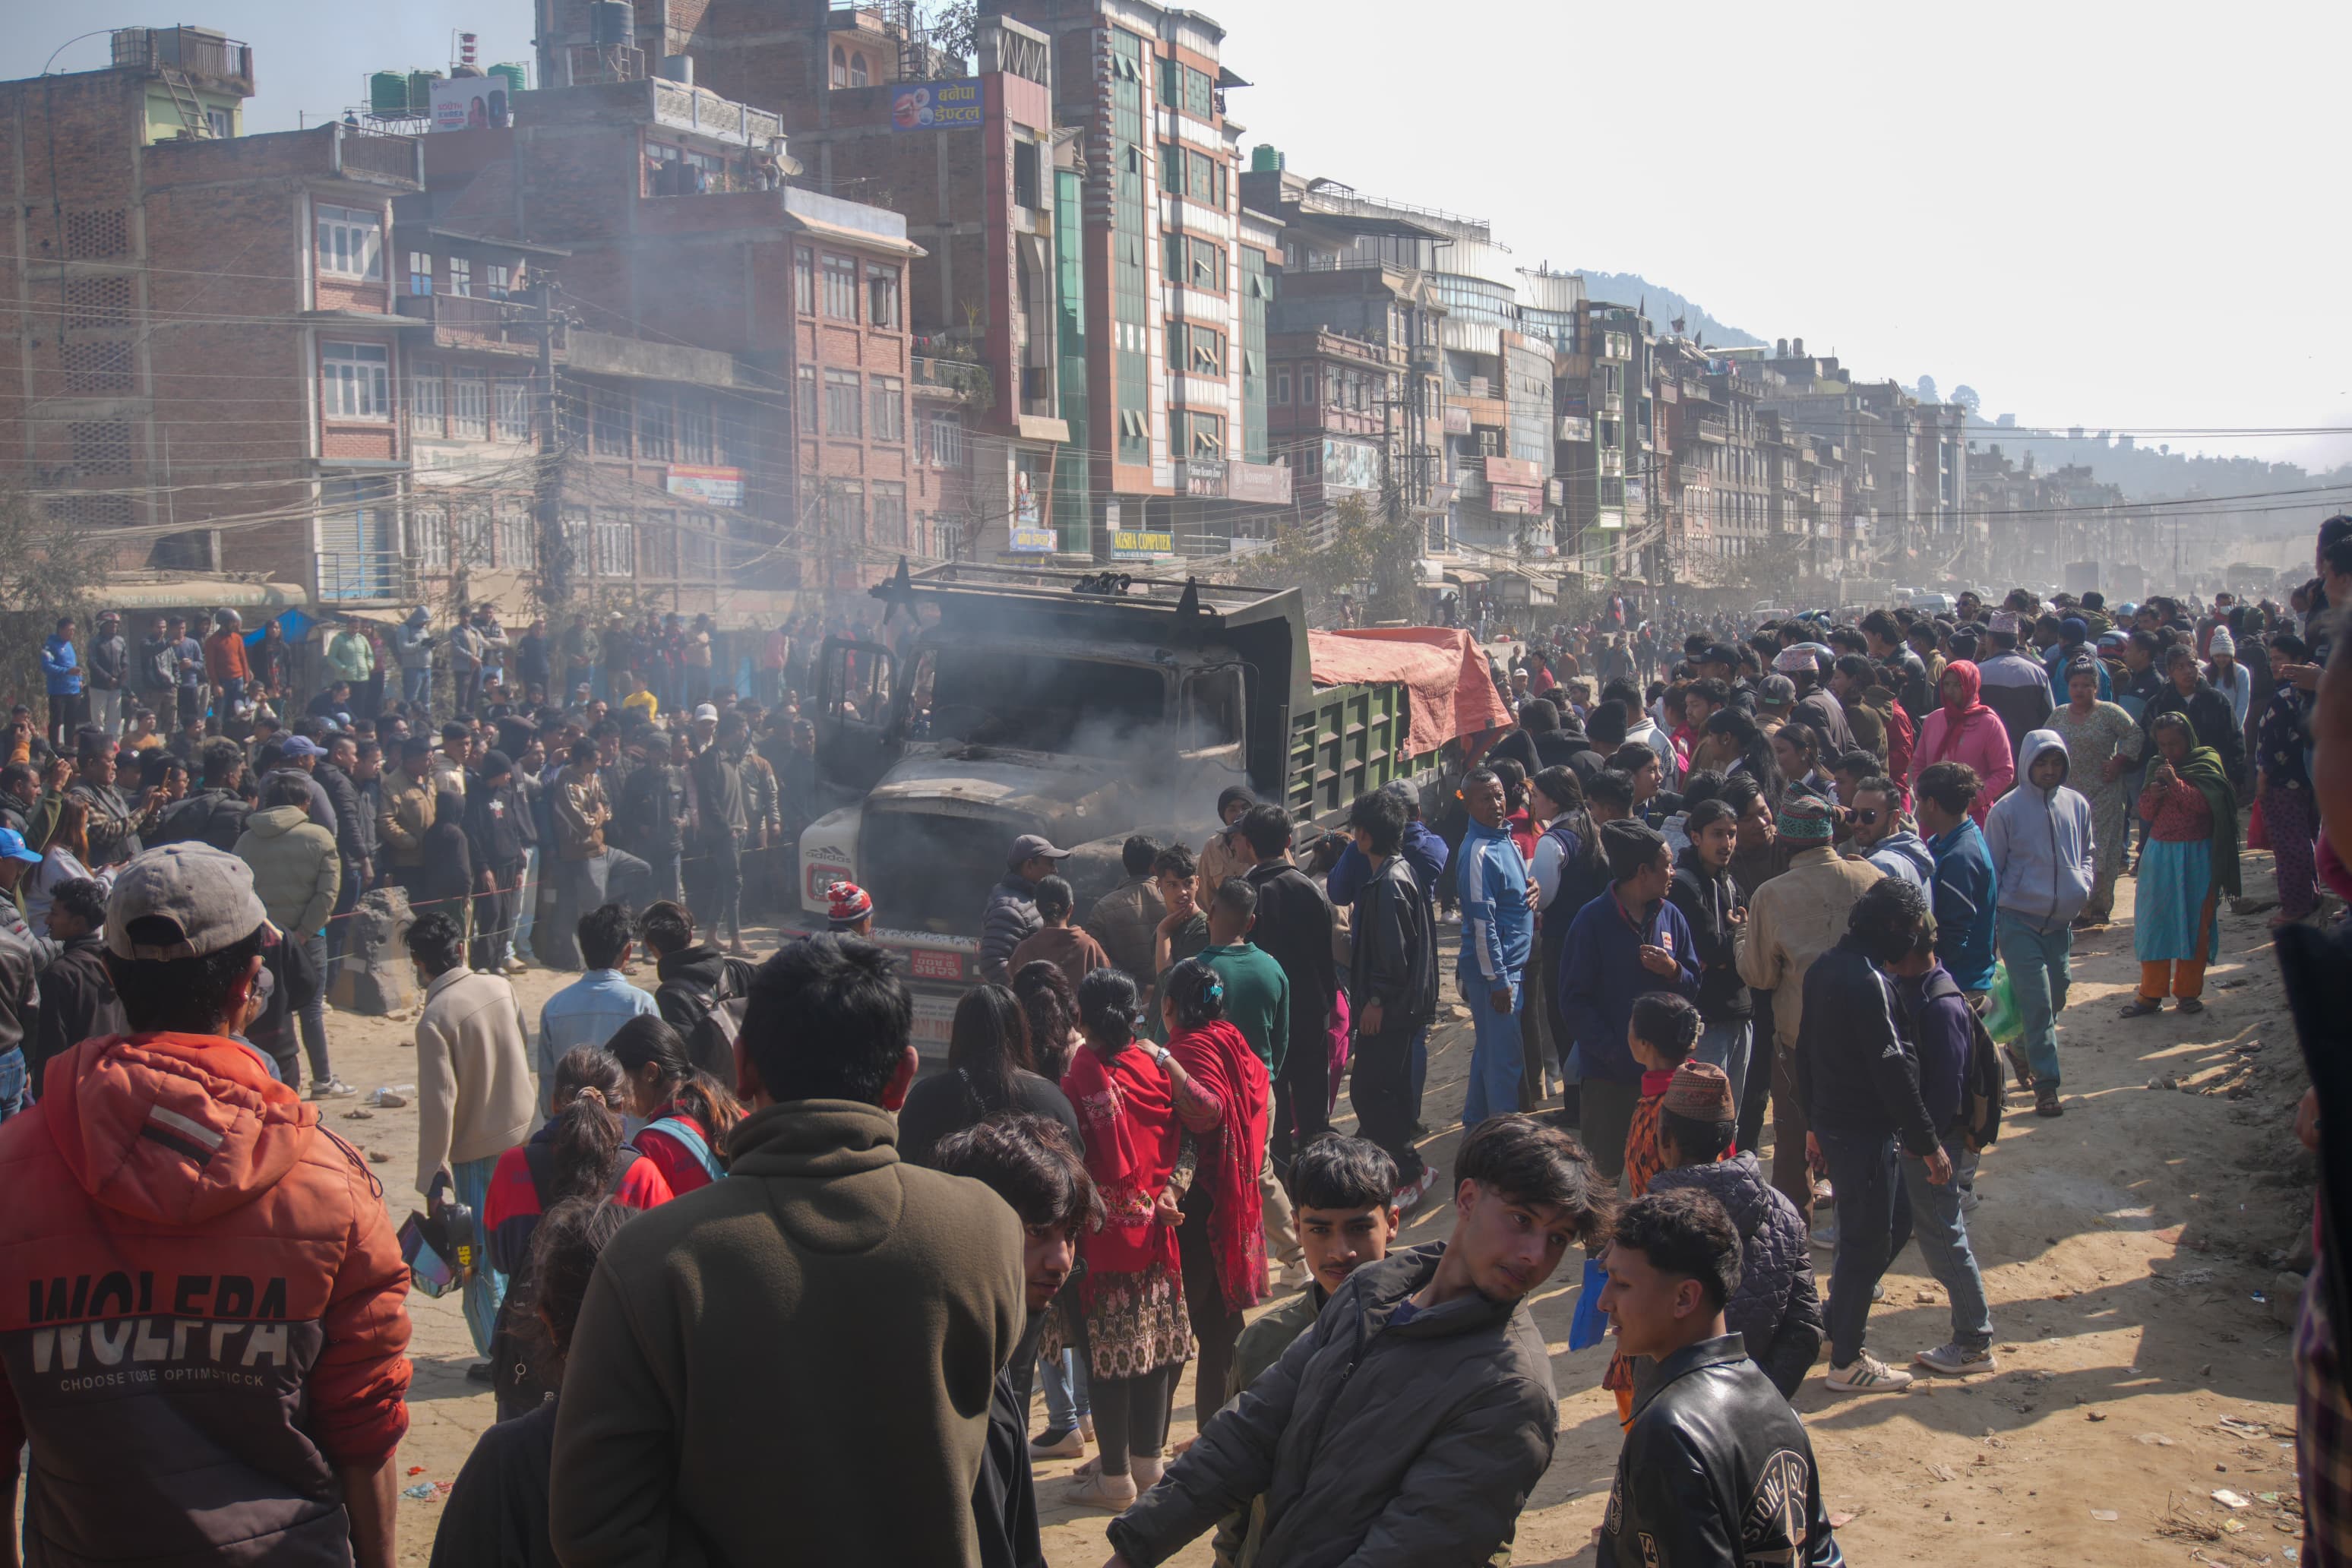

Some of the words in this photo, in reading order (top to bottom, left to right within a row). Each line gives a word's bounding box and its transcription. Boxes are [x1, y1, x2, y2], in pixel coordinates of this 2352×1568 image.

[938, 84, 975, 101] बनेपा
[934, 105, 980, 122] डेण्टल
[1244, 468, 1273, 485] November
[1114, 532, 1137, 549] AGSHA
[1138, 533, 1171, 551] COMPUTER
[805, 852, 851, 864] adidas
[457, 1245, 472, 1266] 46
[61, 1372, 125, 1392] CHOOSE
[1743, 1465, 1785, 1542] STONE
